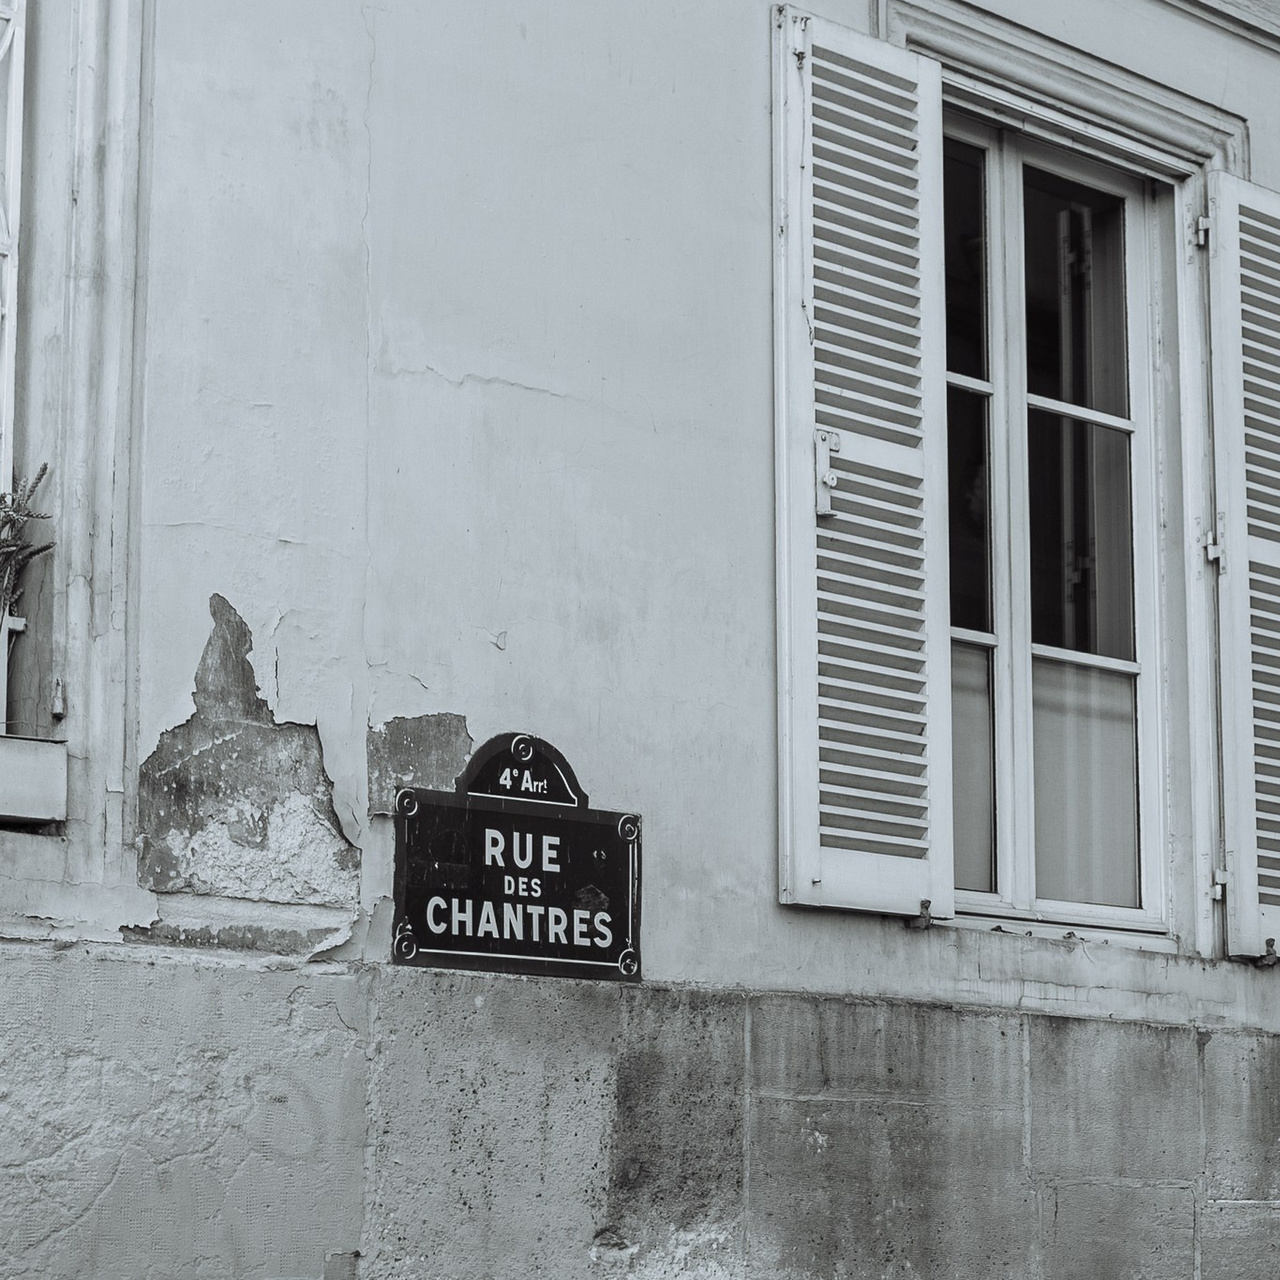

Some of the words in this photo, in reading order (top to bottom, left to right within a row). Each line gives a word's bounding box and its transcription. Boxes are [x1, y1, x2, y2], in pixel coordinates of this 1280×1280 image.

[484, 828, 561, 873] RUE
[504, 875, 542, 898] DES
[426, 896, 613, 949] CHANTRES
